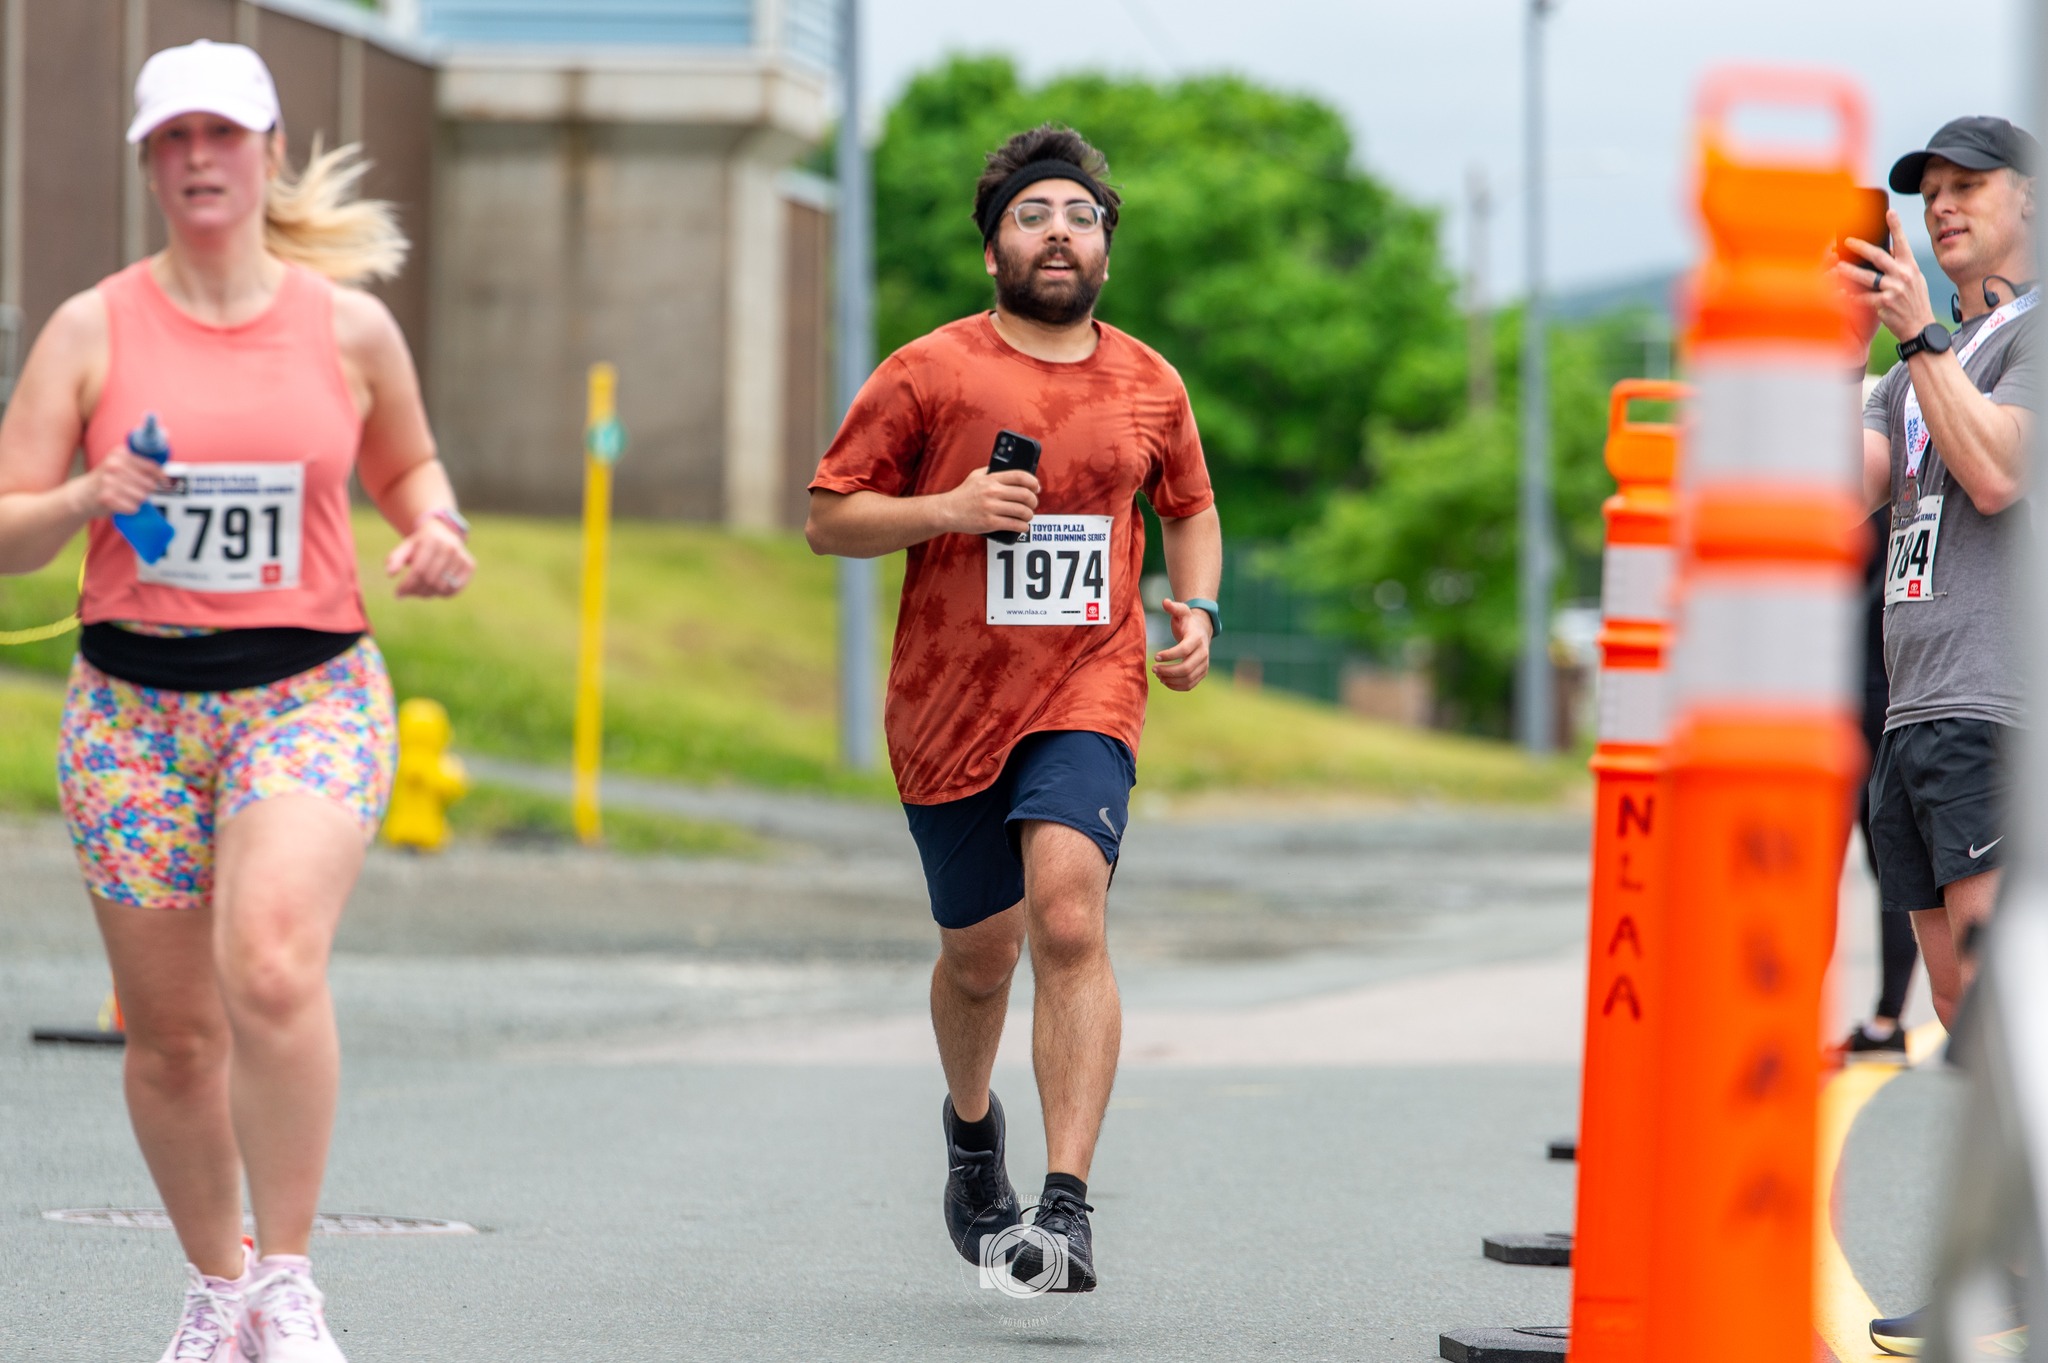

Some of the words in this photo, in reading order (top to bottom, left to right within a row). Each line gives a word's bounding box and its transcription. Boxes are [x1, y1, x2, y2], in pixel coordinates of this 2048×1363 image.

[157, 504, 281, 562] 791
[1032, 524, 1061, 532] TOYOTA
[1063, 524, 1085, 532] PLAZA
[1032, 533, 1052, 541] ROAD
[1054, 533, 1086, 541] RUNNING
[1087, 533, 1106, 541] SERIES
[996, 549, 1104, 600] 1974
[1006, 608, 1047, 616] www.nlaa.ca
[1602, 794, 1656, 1021] NLAA
